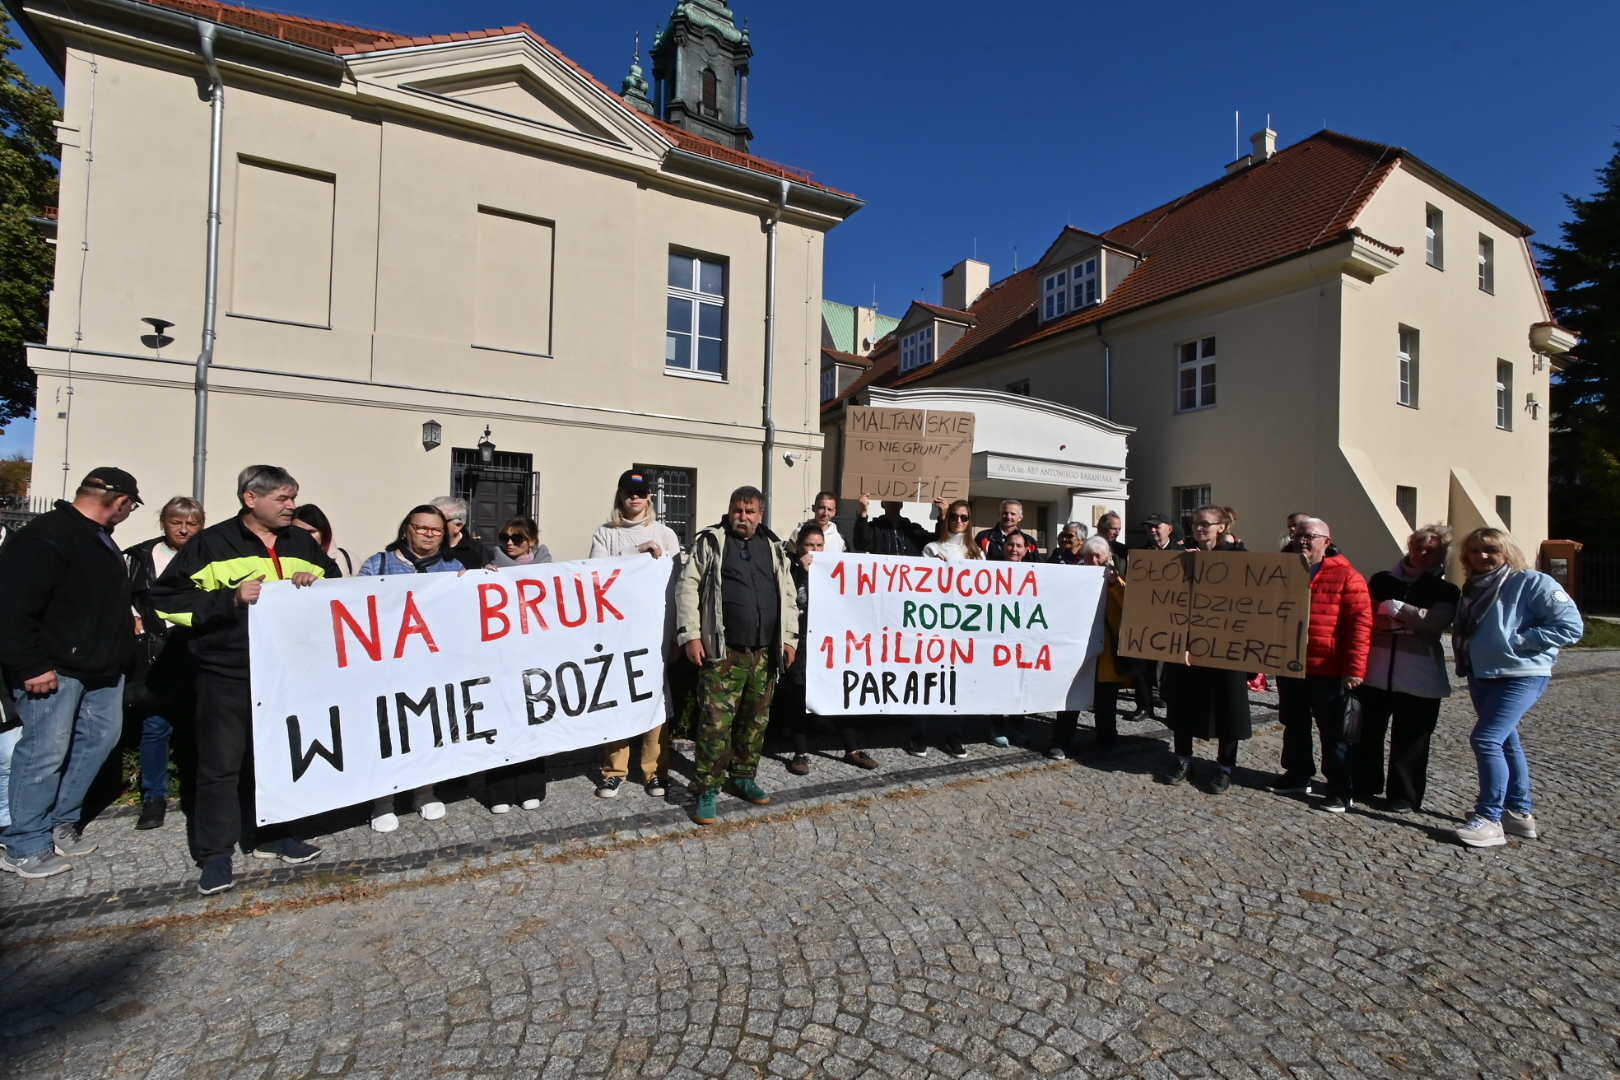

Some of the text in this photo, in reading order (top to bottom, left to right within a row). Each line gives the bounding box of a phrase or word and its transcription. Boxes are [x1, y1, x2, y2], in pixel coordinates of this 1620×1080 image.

[856, 439, 874, 452] TO
[879, 441, 900, 454] NIE
[902, 442, 950, 456] GRUNT
[882, 458, 917, 473] TO
[998, 463, 1016, 473] AULA
[1026, 466, 1039, 475] ABP
[1040, 469, 1079, 480] ANTONIEGO
[1080, 473, 1113, 483] BARANIAKA
[830, 559, 1039, 597] 1 WYRZUCONA
[1131, 559, 1288, 588] SŁOWO NA
[330, 568, 625, 668] NA BRUK
[902, 600, 1049, 634] RODZINA
[819, 635, 834, 669] 1
[992, 643, 1052, 671] DLA
[286, 643, 654, 783] W IMIĘ BOŻE
